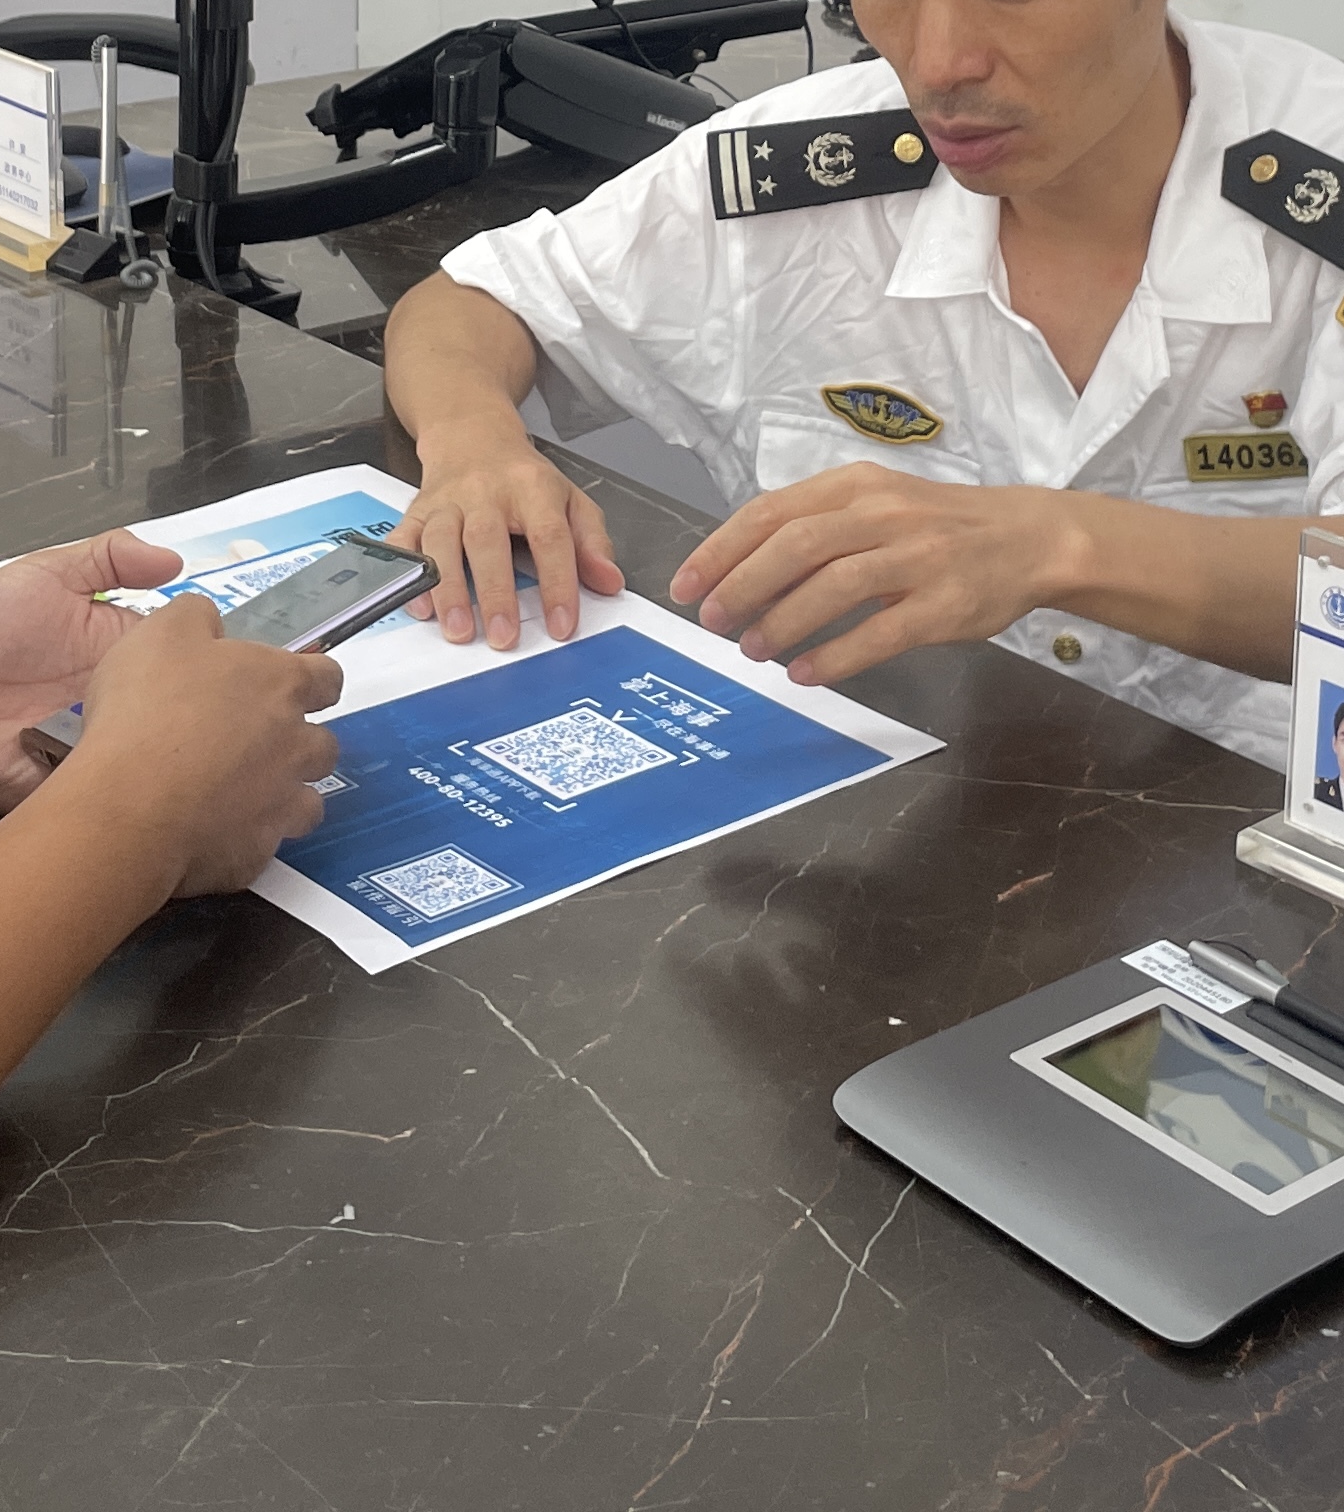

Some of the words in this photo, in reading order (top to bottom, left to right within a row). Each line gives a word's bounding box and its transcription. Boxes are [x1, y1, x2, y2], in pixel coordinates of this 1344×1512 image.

[619, 677, 720, 728] 掌上海事
[408, 766, 514, 828] 400-80-12395
